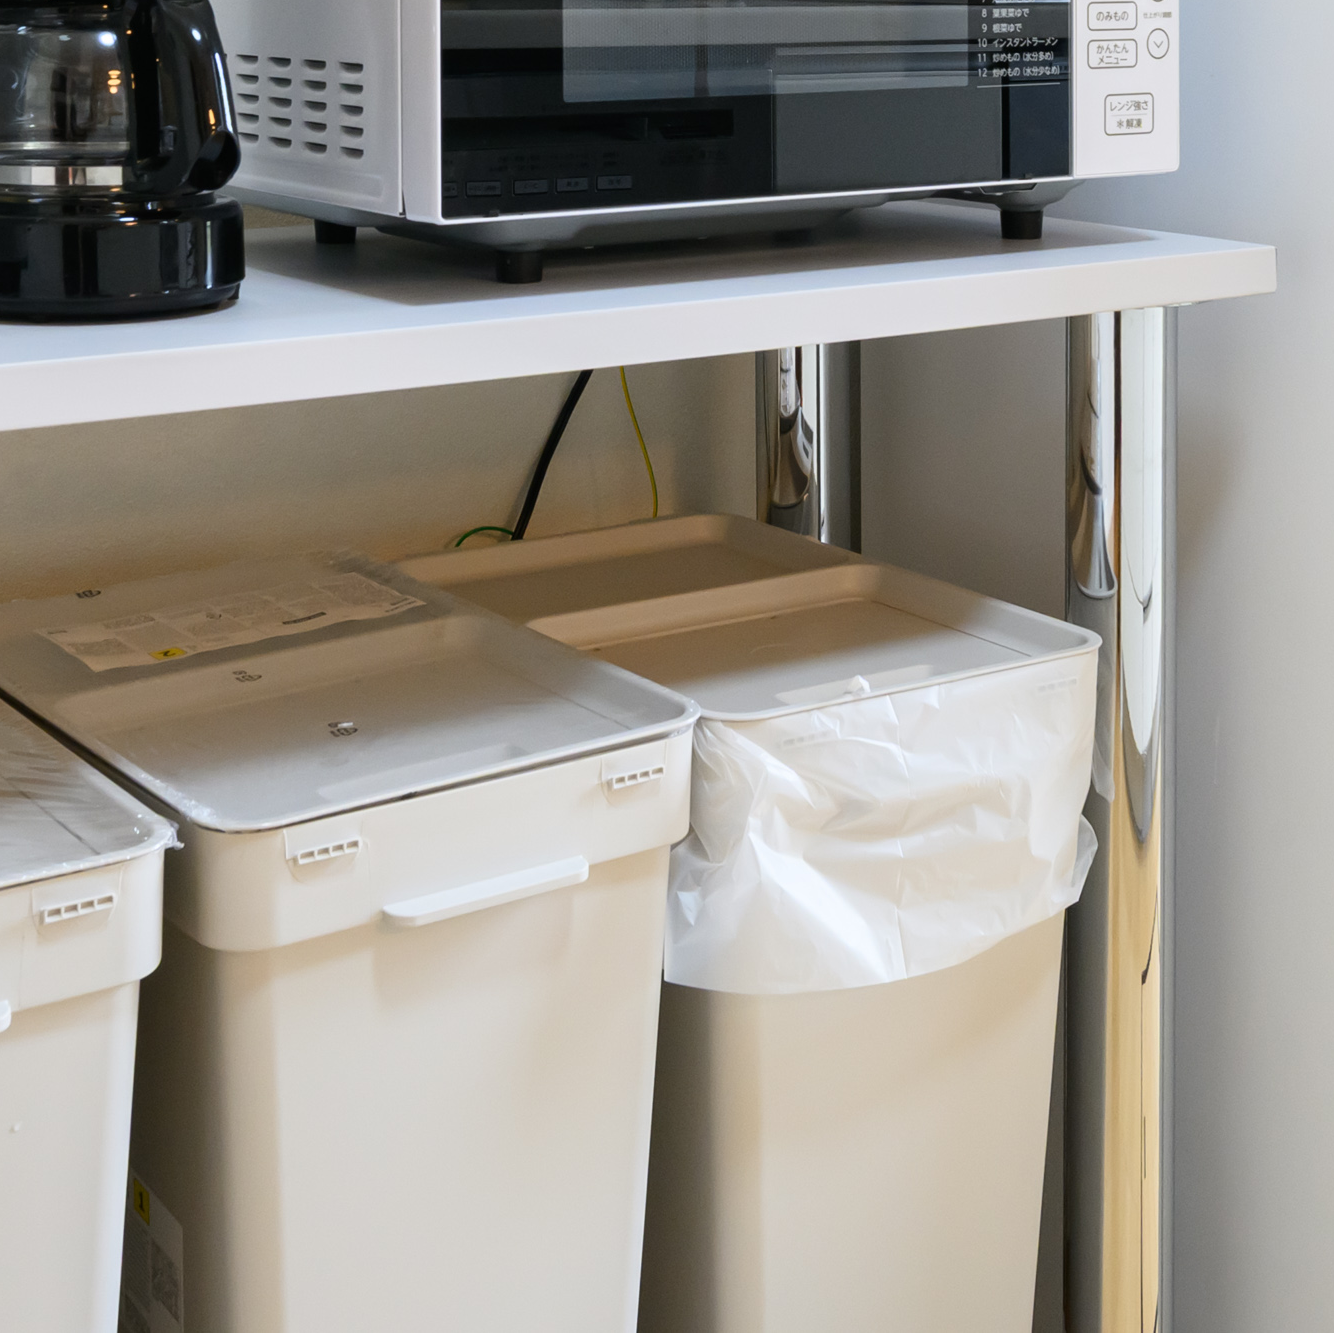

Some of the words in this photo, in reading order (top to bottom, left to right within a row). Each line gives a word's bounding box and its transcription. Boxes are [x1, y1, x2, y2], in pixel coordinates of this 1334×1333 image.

[981, 8, 987, 18] 8
[1096, 11, 1129, 22] のみもの
[981, 23, 987, 33] 9
[977, 38, 988, 48] 10
[992, 36, 1058, 47] インスタントラーメン
[1096, 43, 1129, 54] かんたん
[977, 53, 987, 63] 11
[1097, 55, 1128, 66] メニュー
[977, 68, 988, 78] 12
[1109, 100, 1149, 112] レンジ強さ
